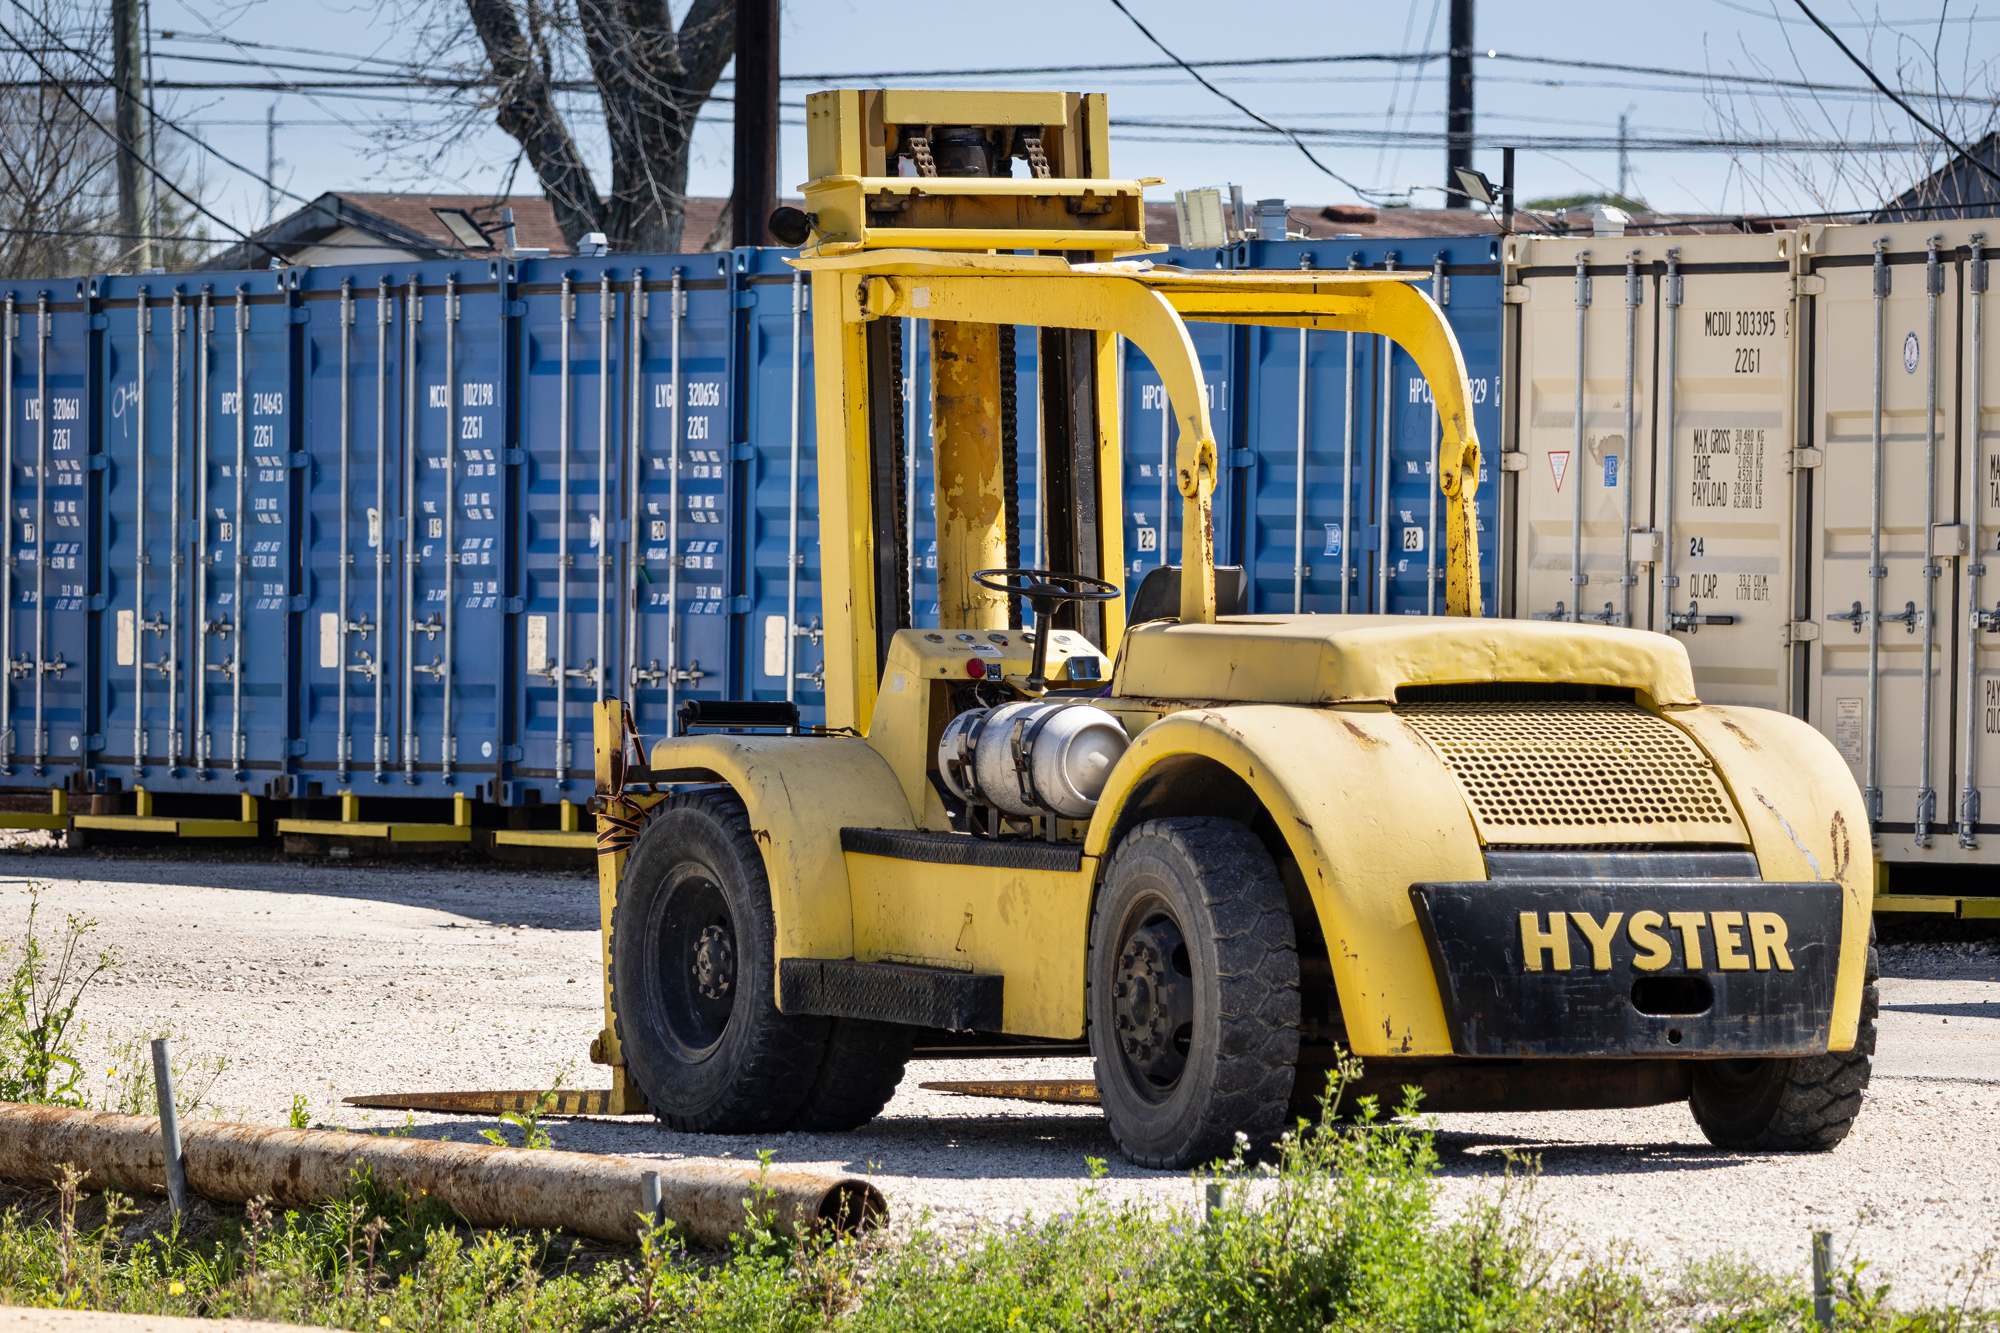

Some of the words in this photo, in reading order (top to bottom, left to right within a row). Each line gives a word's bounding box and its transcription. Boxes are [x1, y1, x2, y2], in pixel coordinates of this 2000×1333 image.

[1705, 311, 1731, 336] MCDU
[1735, 311, 1776, 336] 303395
[1735, 348, 1760, 373] 22G1
[253, 393, 283, 415] 214643
[463, 383, 493, 406] 102198
[687, 382, 719, 406] 320656
[53, 398, 79, 420] 320661
[254, 425, 273, 447] 22G1
[462, 416, 483, 439] 22G1
[687, 416, 708, 439] 22G1
[1757, 429, 1764, 442] KG
[53, 429, 70, 450] 22G1
[1693, 429, 1708, 454] MAX
[1711, 429, 1731, 454] GROSS
[1757, 442, 1763, 455] LB
[1693, 455, 1711, 480] TARE
[1756, 456, 1763, 469] KG
[1756, 469, 1762, 482] LB
[1692, 482, 1728, 507] PAYLOAD
[1755, 482, 1762, 495] KG
[1755, 495, 1762, 509] LB
[26, 525, 33, 540] 17
[222, 524, 231, 540] 18
[431, 520, 440, 537] 19
[654, 522, 665, 539] 20
[1141, 530, 1154, 548] 22
[1405, 531, 1418, 549] 23
[1690, 537, 1704, 557] 24
[1739, 574, 1751, 587] 33.2
[1519, 910, 1794, 972] HYSTER
